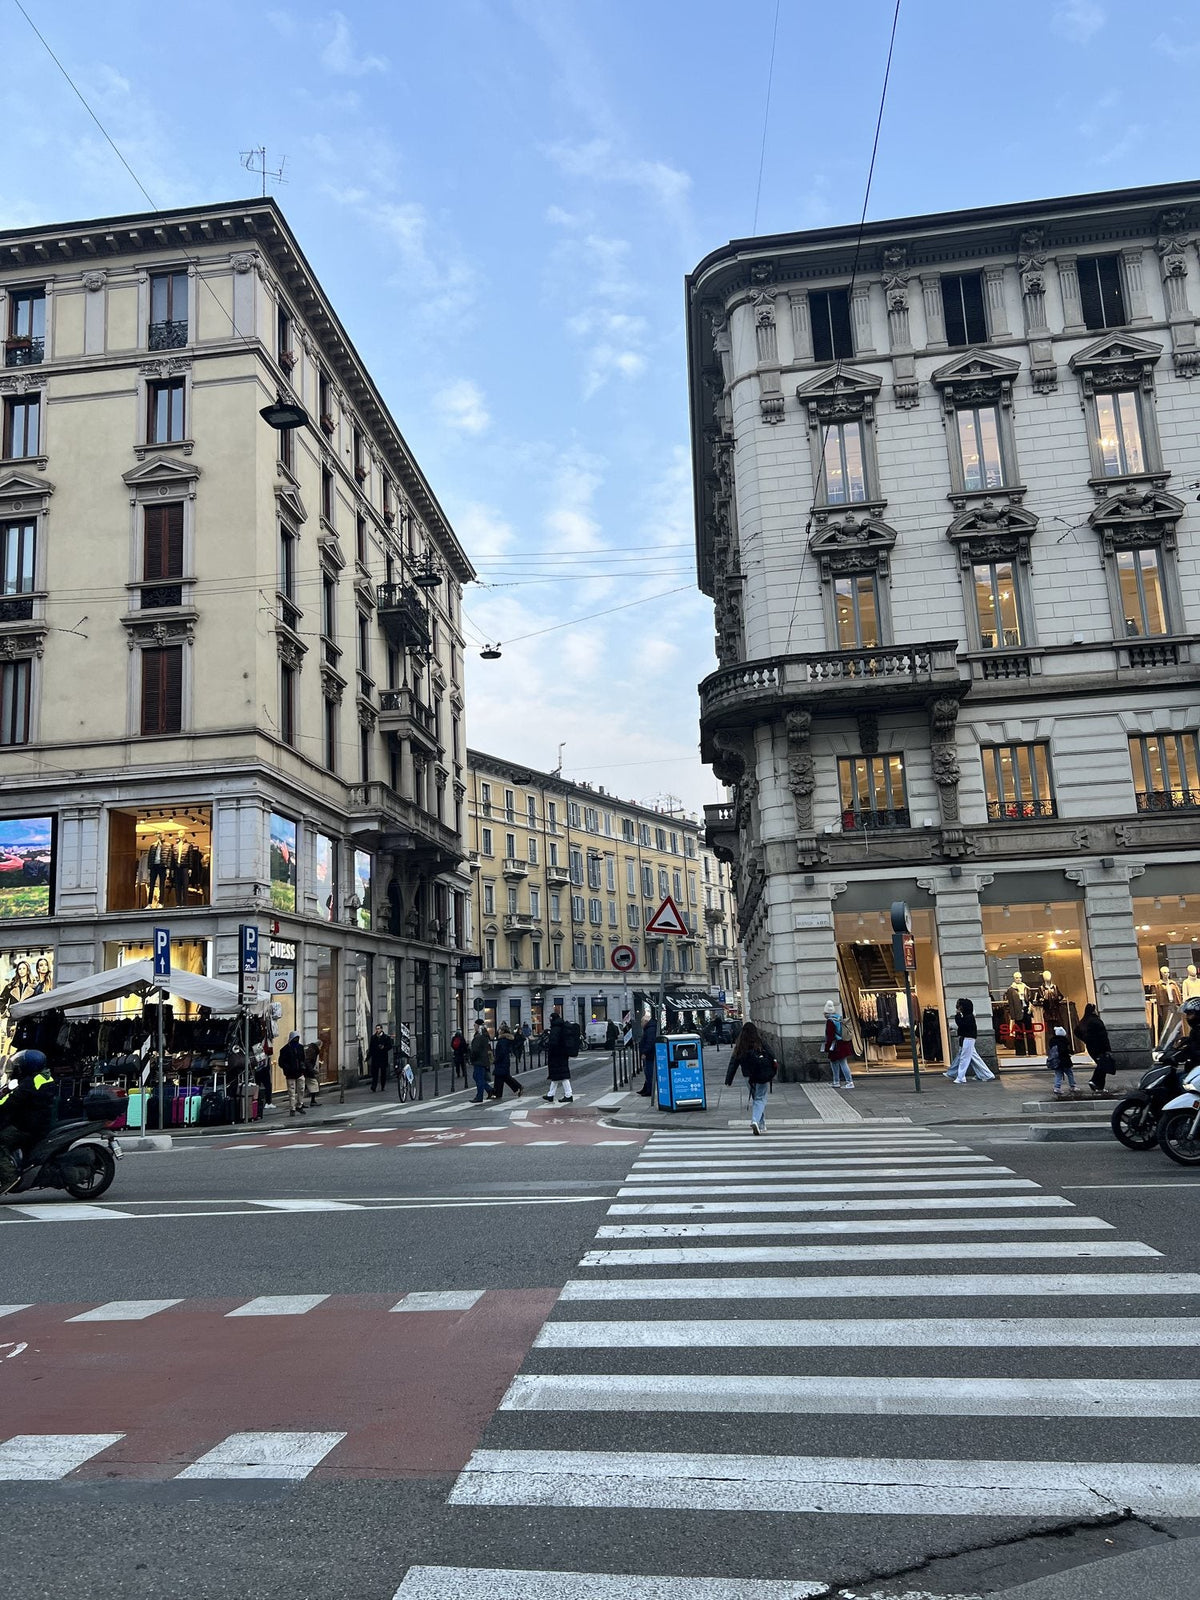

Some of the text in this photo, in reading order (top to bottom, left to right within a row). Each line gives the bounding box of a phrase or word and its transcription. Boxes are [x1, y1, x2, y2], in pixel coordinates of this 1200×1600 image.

[157, 931, 168, 955] P
[246, 928, 256, 951] P
[269, 941, 296, 960] GUESS
[999, 1023, 1048, 1034] SALDI
